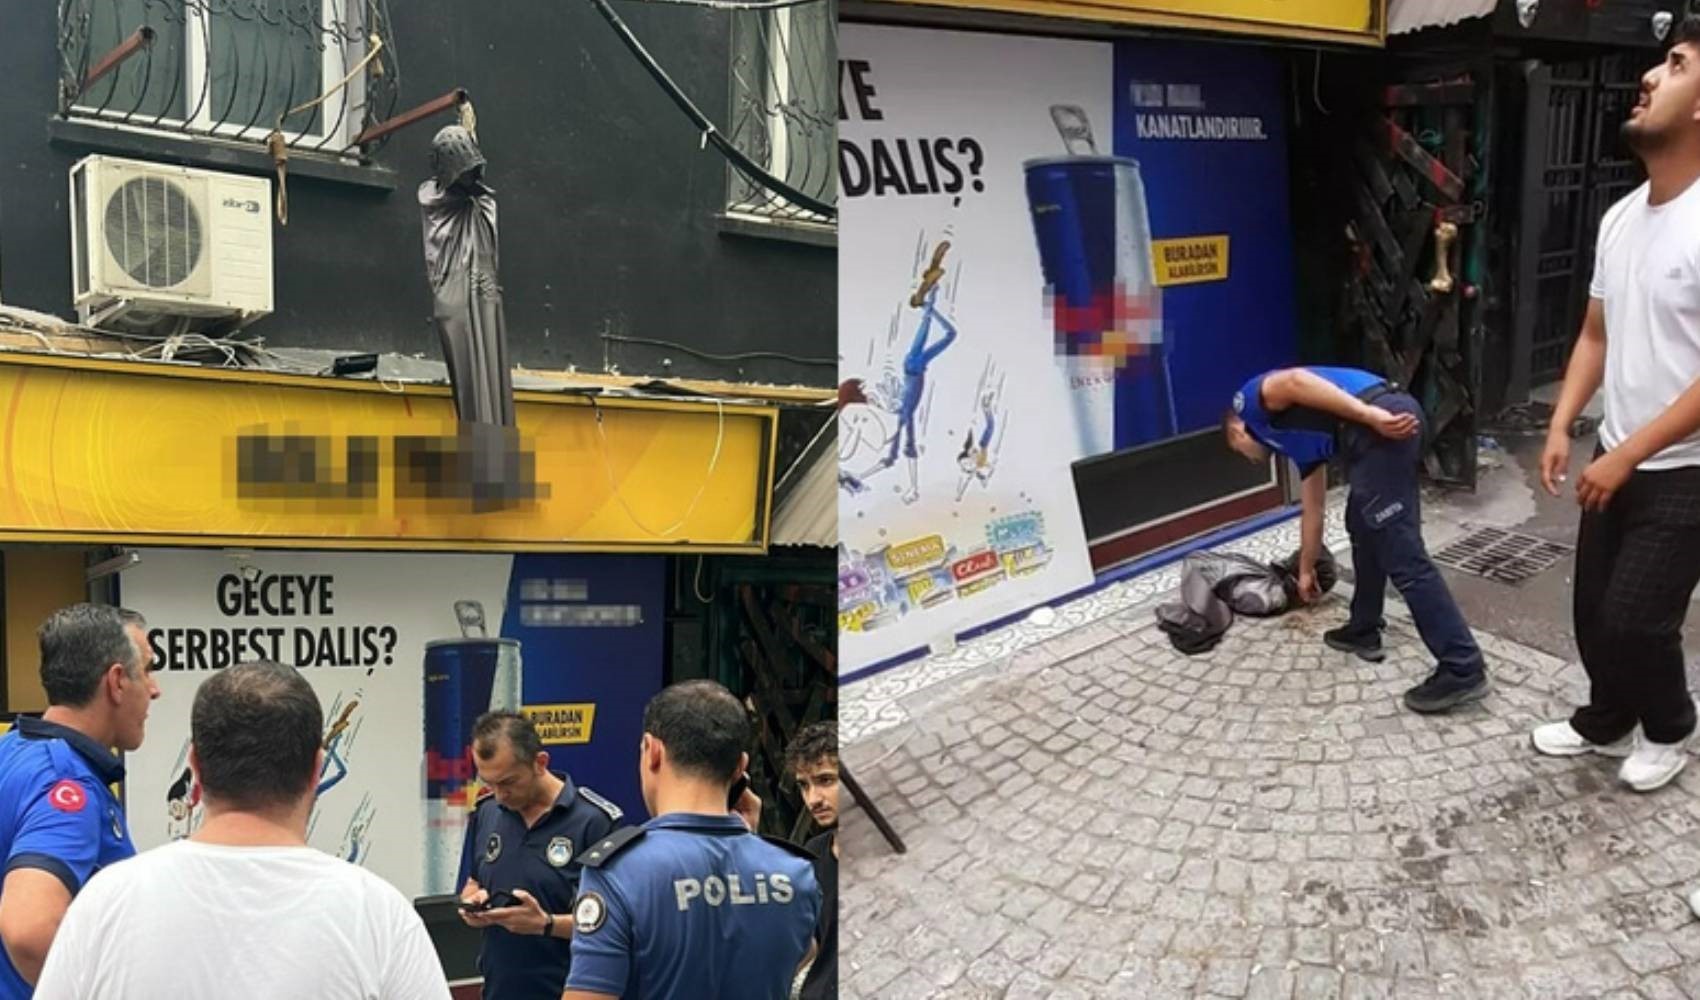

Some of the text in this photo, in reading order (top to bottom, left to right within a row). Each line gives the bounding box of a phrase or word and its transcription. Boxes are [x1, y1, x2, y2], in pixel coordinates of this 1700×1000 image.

[838, 137, 985, 208] DALIŞ?
[1164, 244, 1218, 262] BURADAN
[217, 574, 334, 616] GECEYE
[148, 626, 398, 675] SERBEST DALIŞ?
